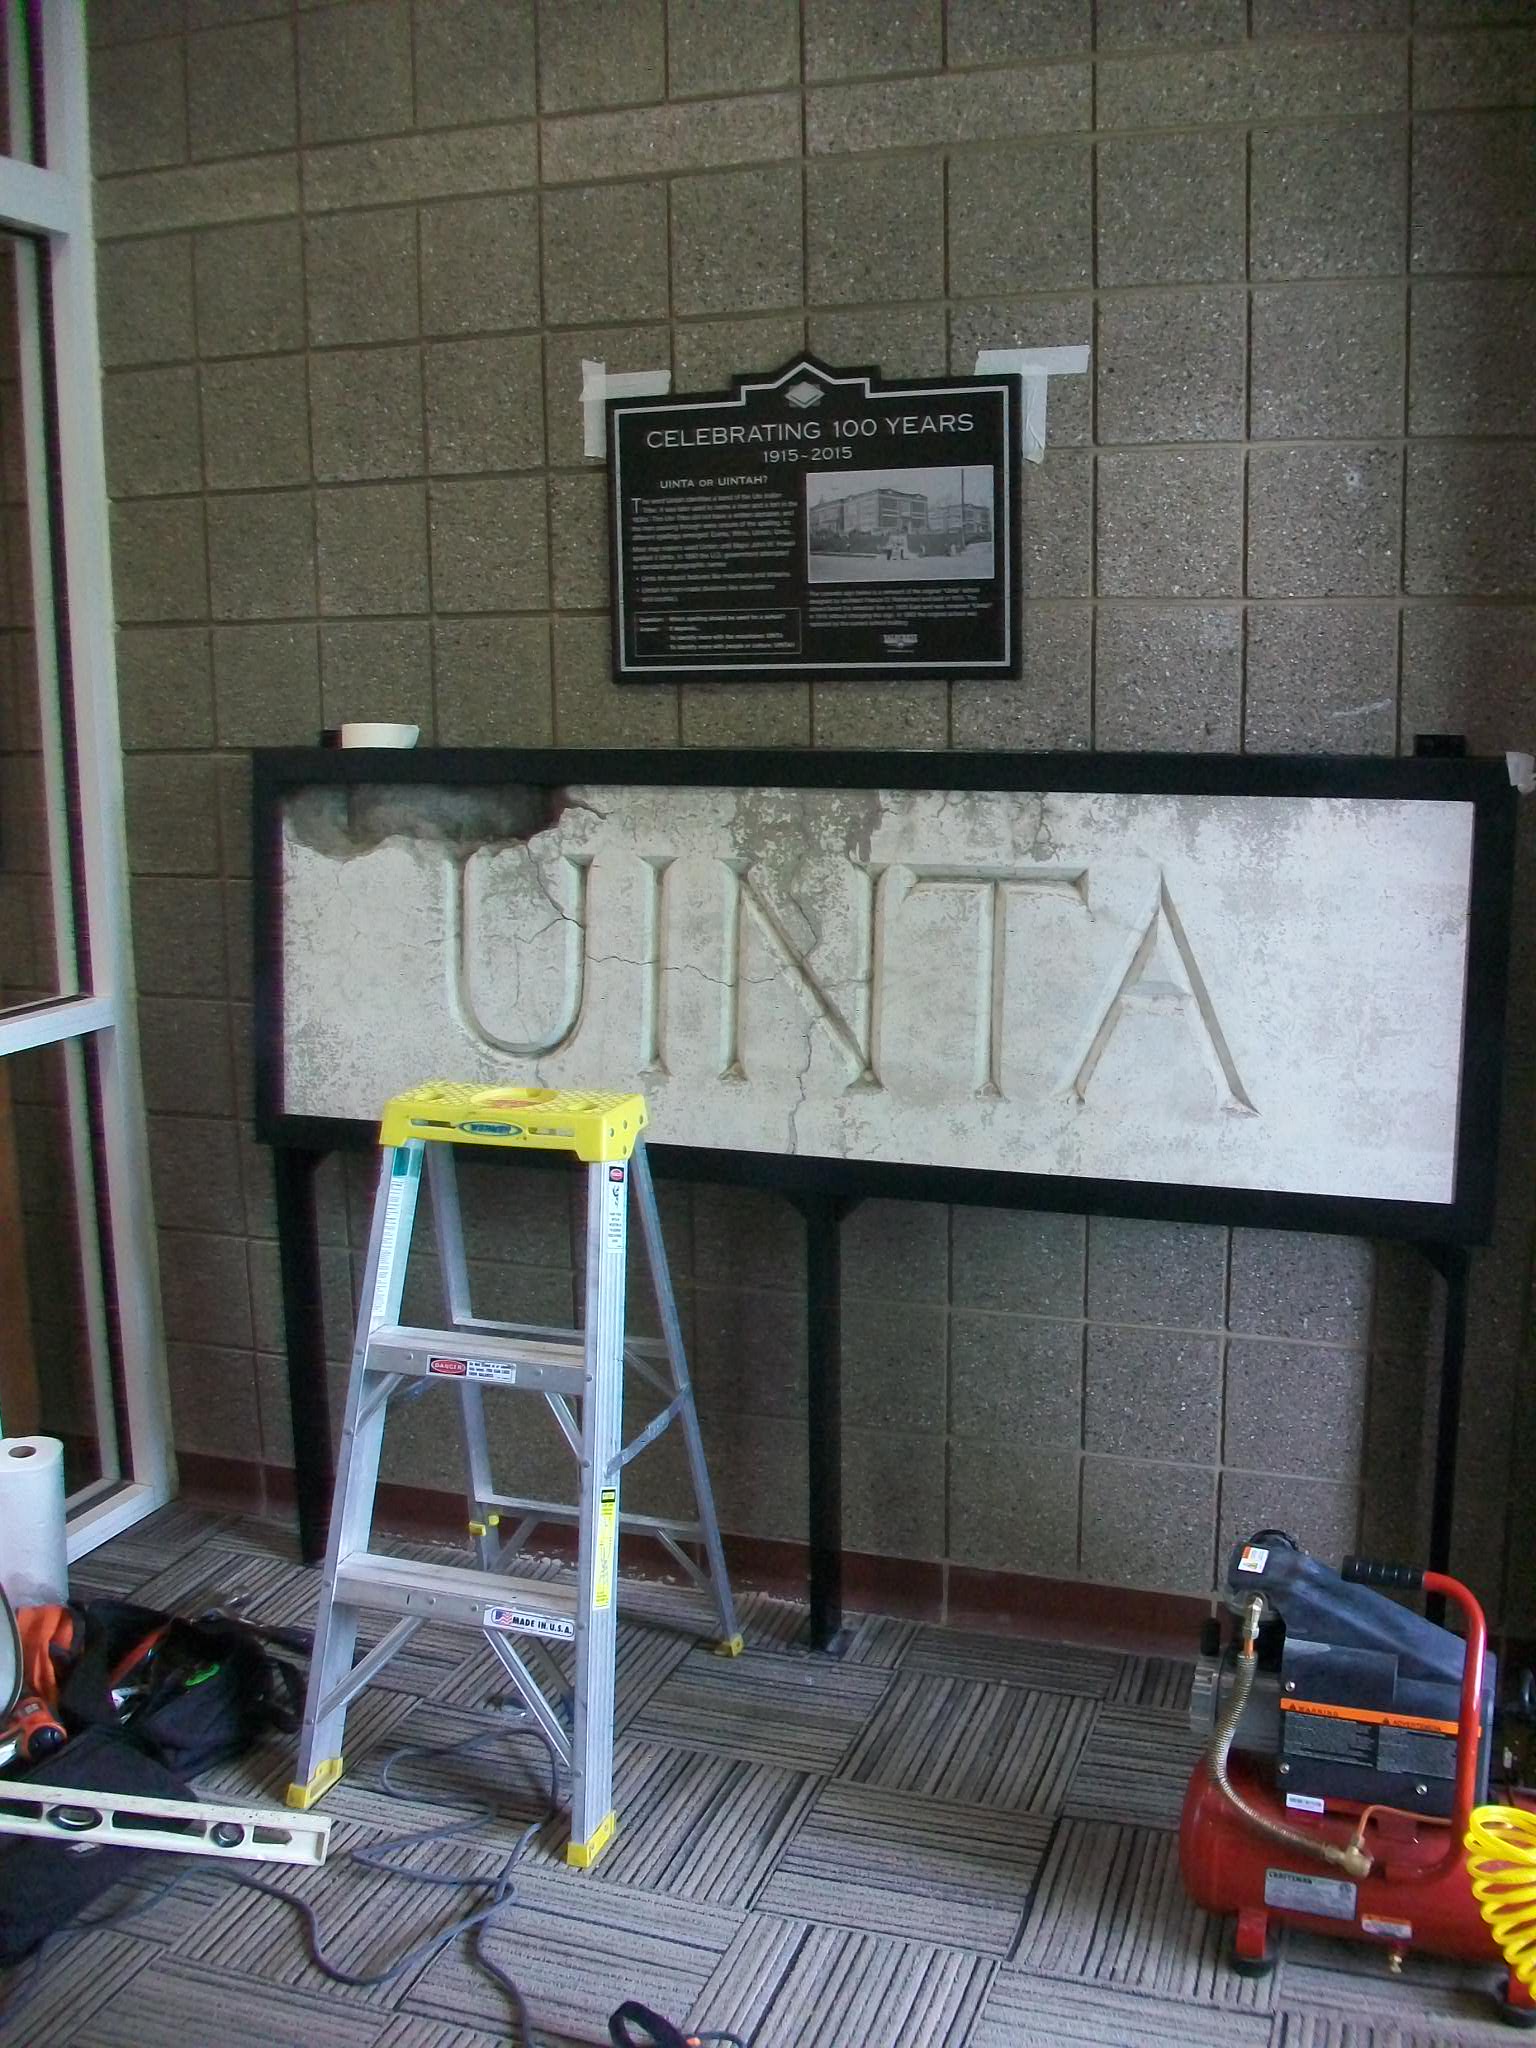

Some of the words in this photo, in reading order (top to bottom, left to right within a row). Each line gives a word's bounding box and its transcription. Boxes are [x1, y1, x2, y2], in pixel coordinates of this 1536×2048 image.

[646, 421, 822, 449] CELEBRATING
[832, 418, 878, 439] 100
[885, 413, 975, 436] YEARS
[659, 478, 695, 489] UINTA
[717, 475, 768, 488] UINTAH?
[442, 854, 1262, 1118] UINTA
[512, 1616, 535, 1628] MADE
[537, 1620, 547, 1630] IN
[549, 1623, 572, 1634] U.S.A.
